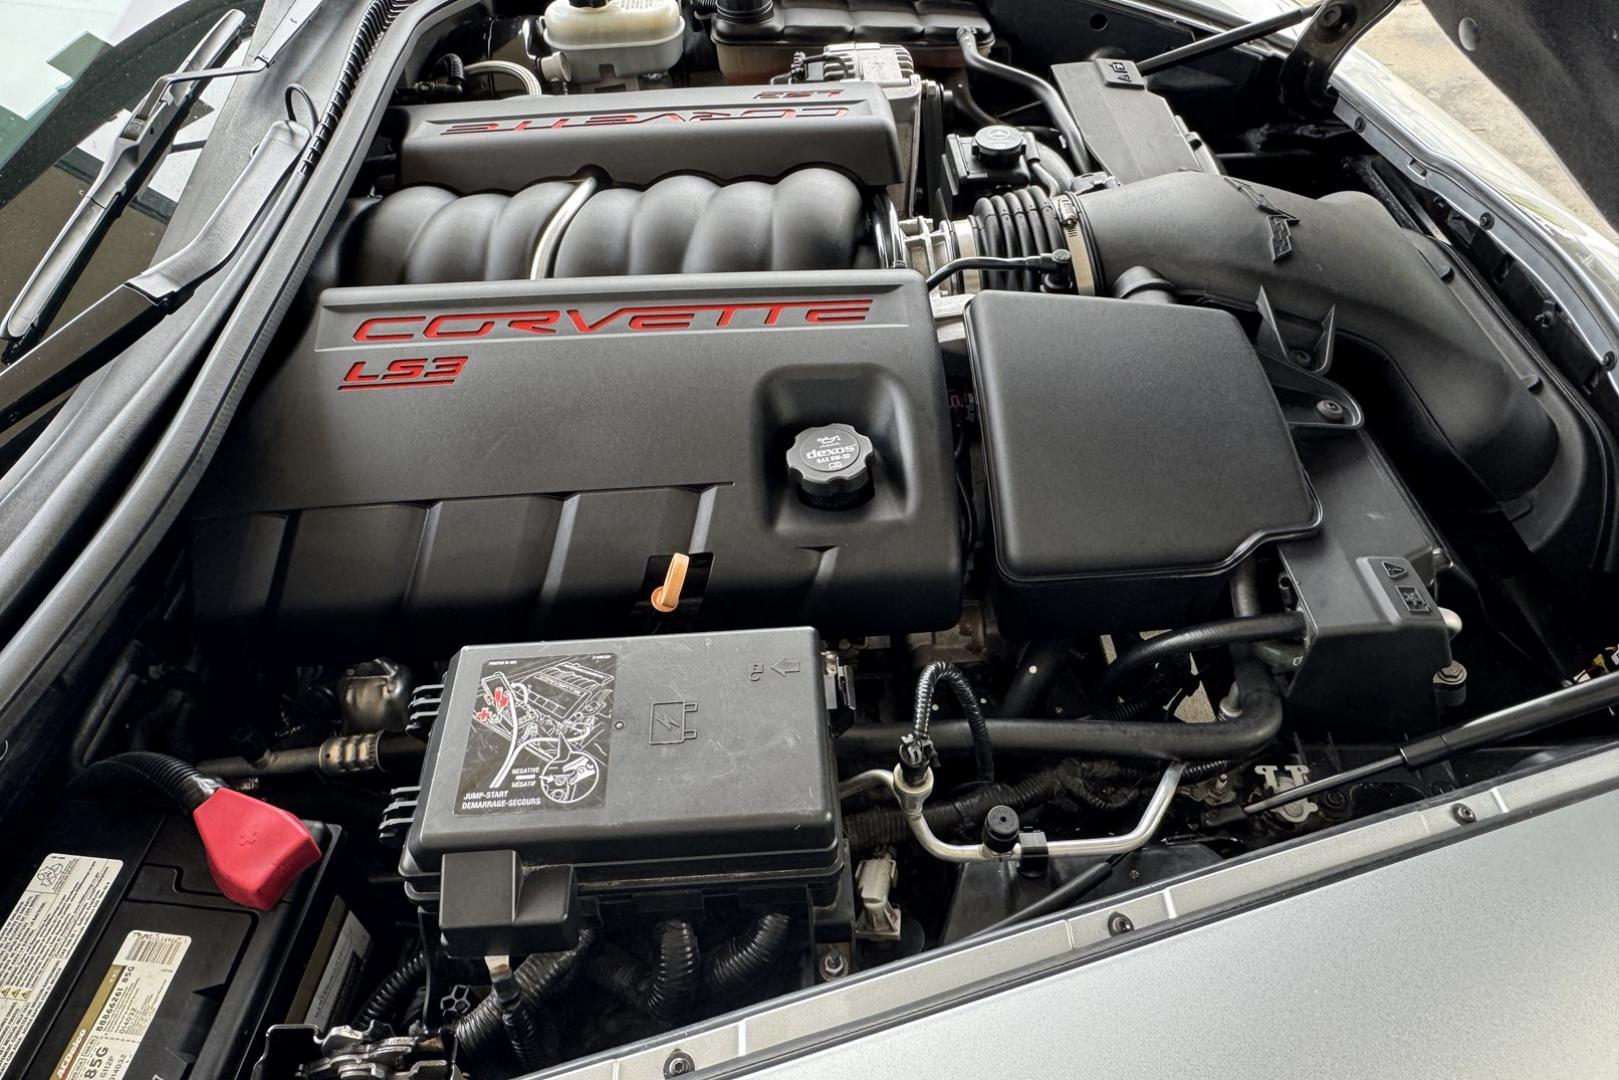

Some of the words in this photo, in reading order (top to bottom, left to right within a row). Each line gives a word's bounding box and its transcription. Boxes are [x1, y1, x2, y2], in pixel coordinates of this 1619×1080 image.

[753, 89, 845, 99] LS3
[440, 107, 849, 136] CORVETTE
[353, 299, 873, 342] CORVETTE
[343, 356, 469, 383] LS3
[806, 445, 855, 459] dexos
[511, 767, 540, 775] NEGATIVE
[463, 790, 509, 800] JUMP-START
[56, 1028, 86, 1078] ACDelco
[83, 1044, 109, 1080] 85G
